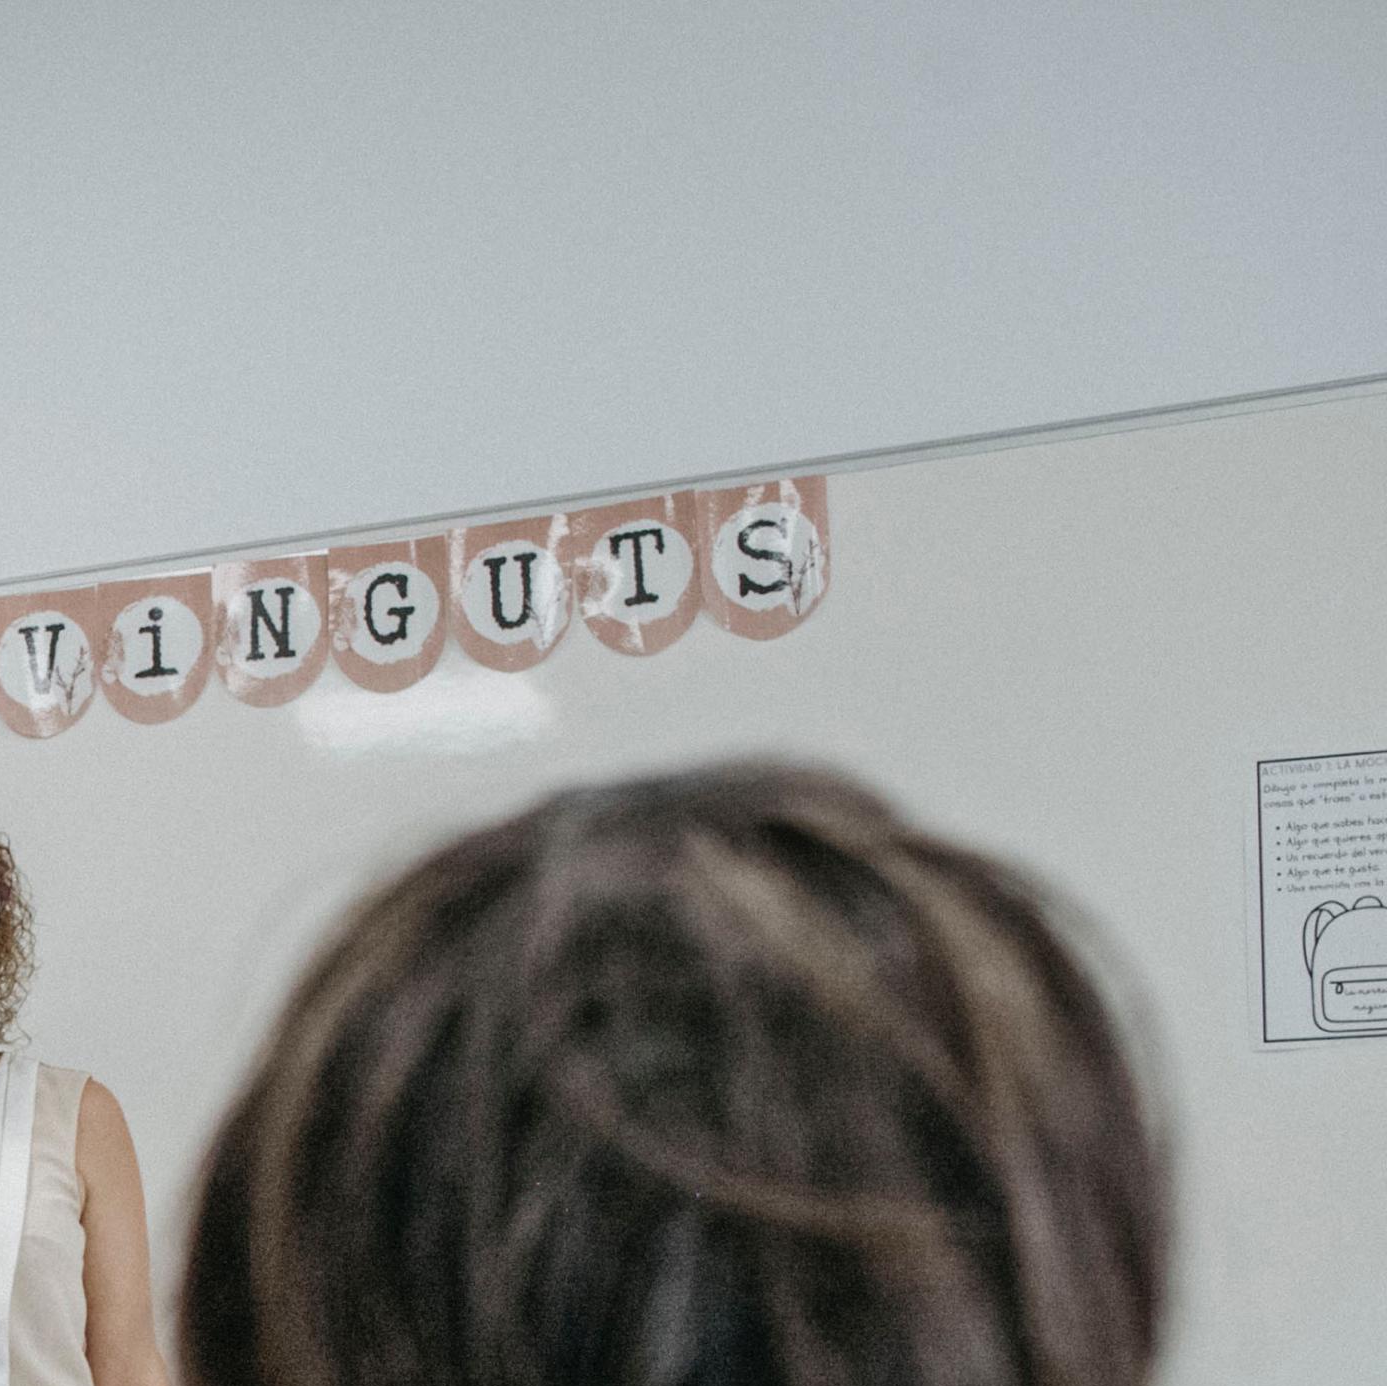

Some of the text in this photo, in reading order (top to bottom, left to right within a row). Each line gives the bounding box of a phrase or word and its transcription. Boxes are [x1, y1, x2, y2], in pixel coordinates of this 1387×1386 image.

[1262, 762, 1322, 776] ACTIVIDAD
[1355, 757, 1387, 767] MOC
[1286, 822, 1308, 836] Algo
[1311, 822, 1329, 831] que
[1286, 837, 1308, 850] Algo
[1312, 837, 1329, 847] que
[1287, 868, 1309, 880] Algo
[1313, 868, 1331, 879] que
[1335, 864, 1345, 875] te
